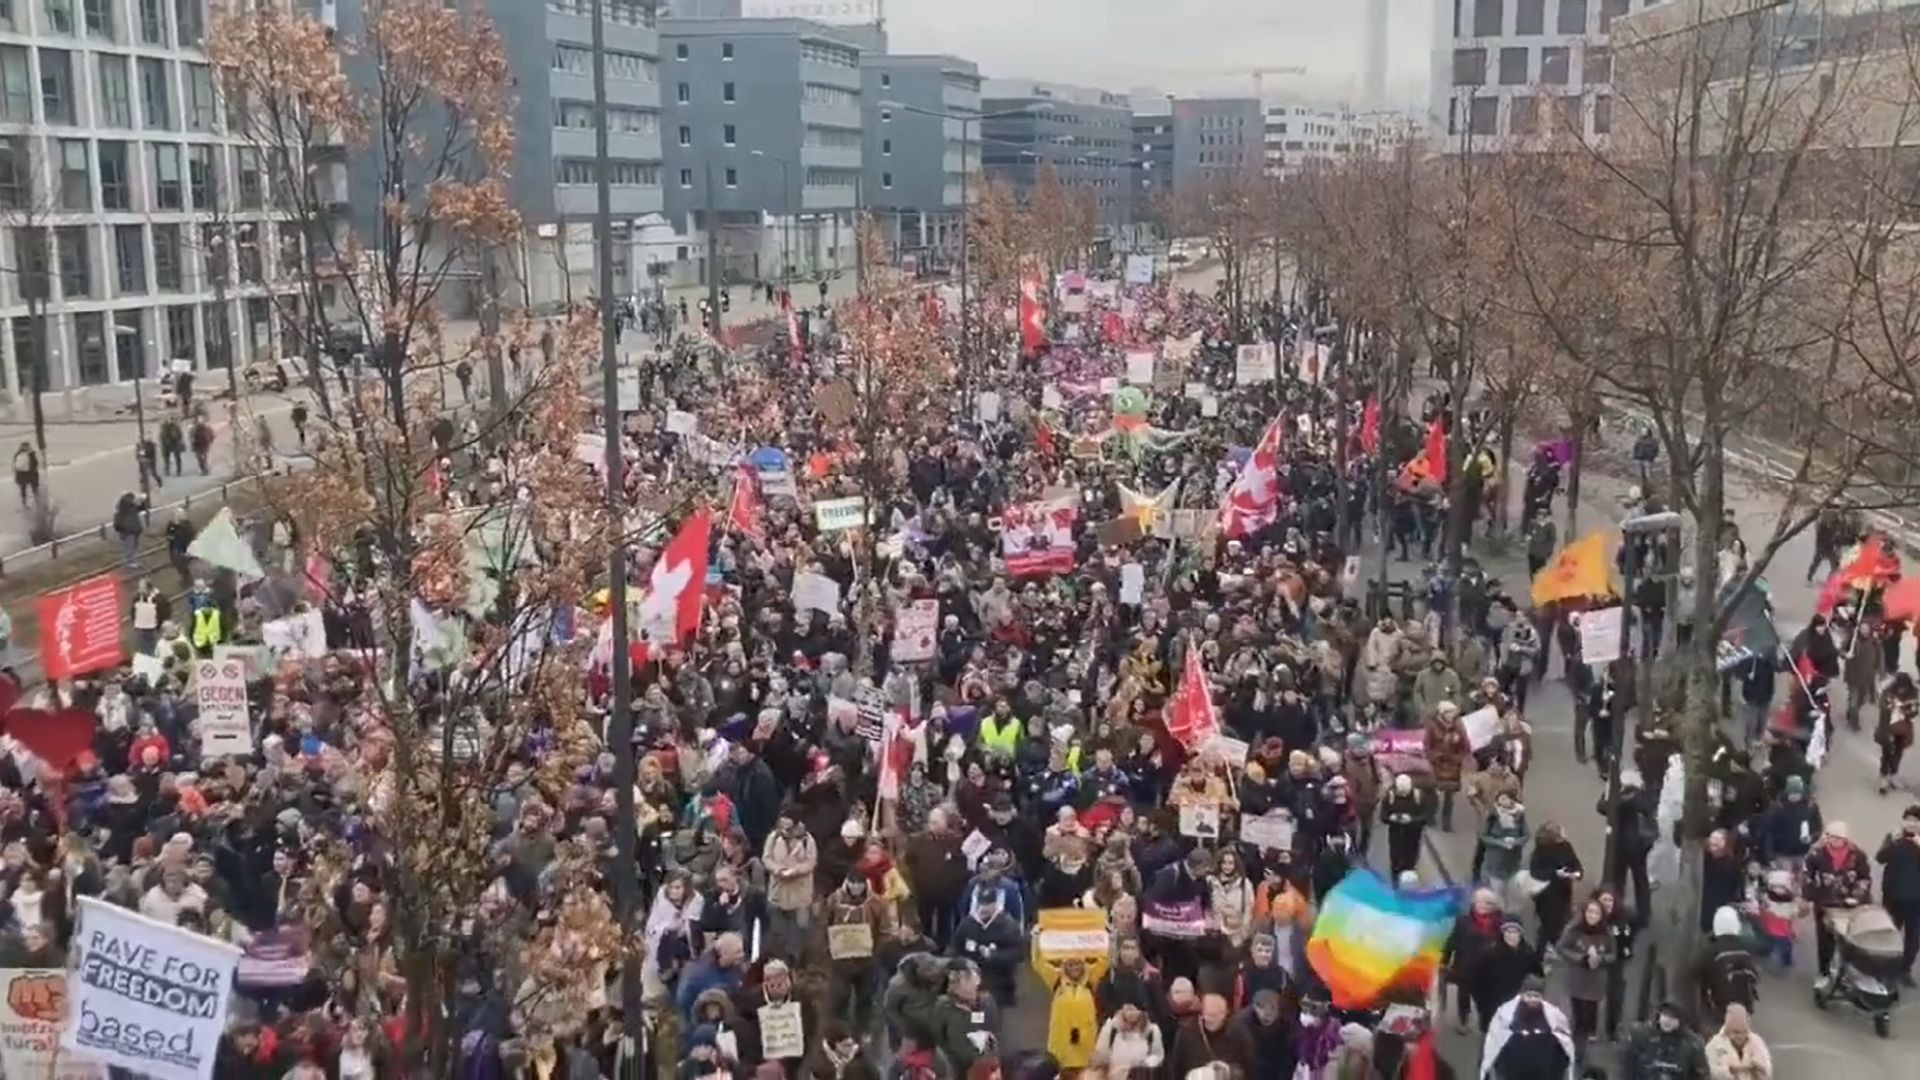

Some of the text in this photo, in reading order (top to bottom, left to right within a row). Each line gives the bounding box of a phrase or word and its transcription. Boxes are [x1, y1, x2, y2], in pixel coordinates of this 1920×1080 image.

[200, 686, 244, 702] GEGEN
[91, 930, 157, 970] RAVE
[163, 956, 220, 986] FOR
[83, 957, 217, 1018] FREEDOM
[81, 998, 195, 1054] based
